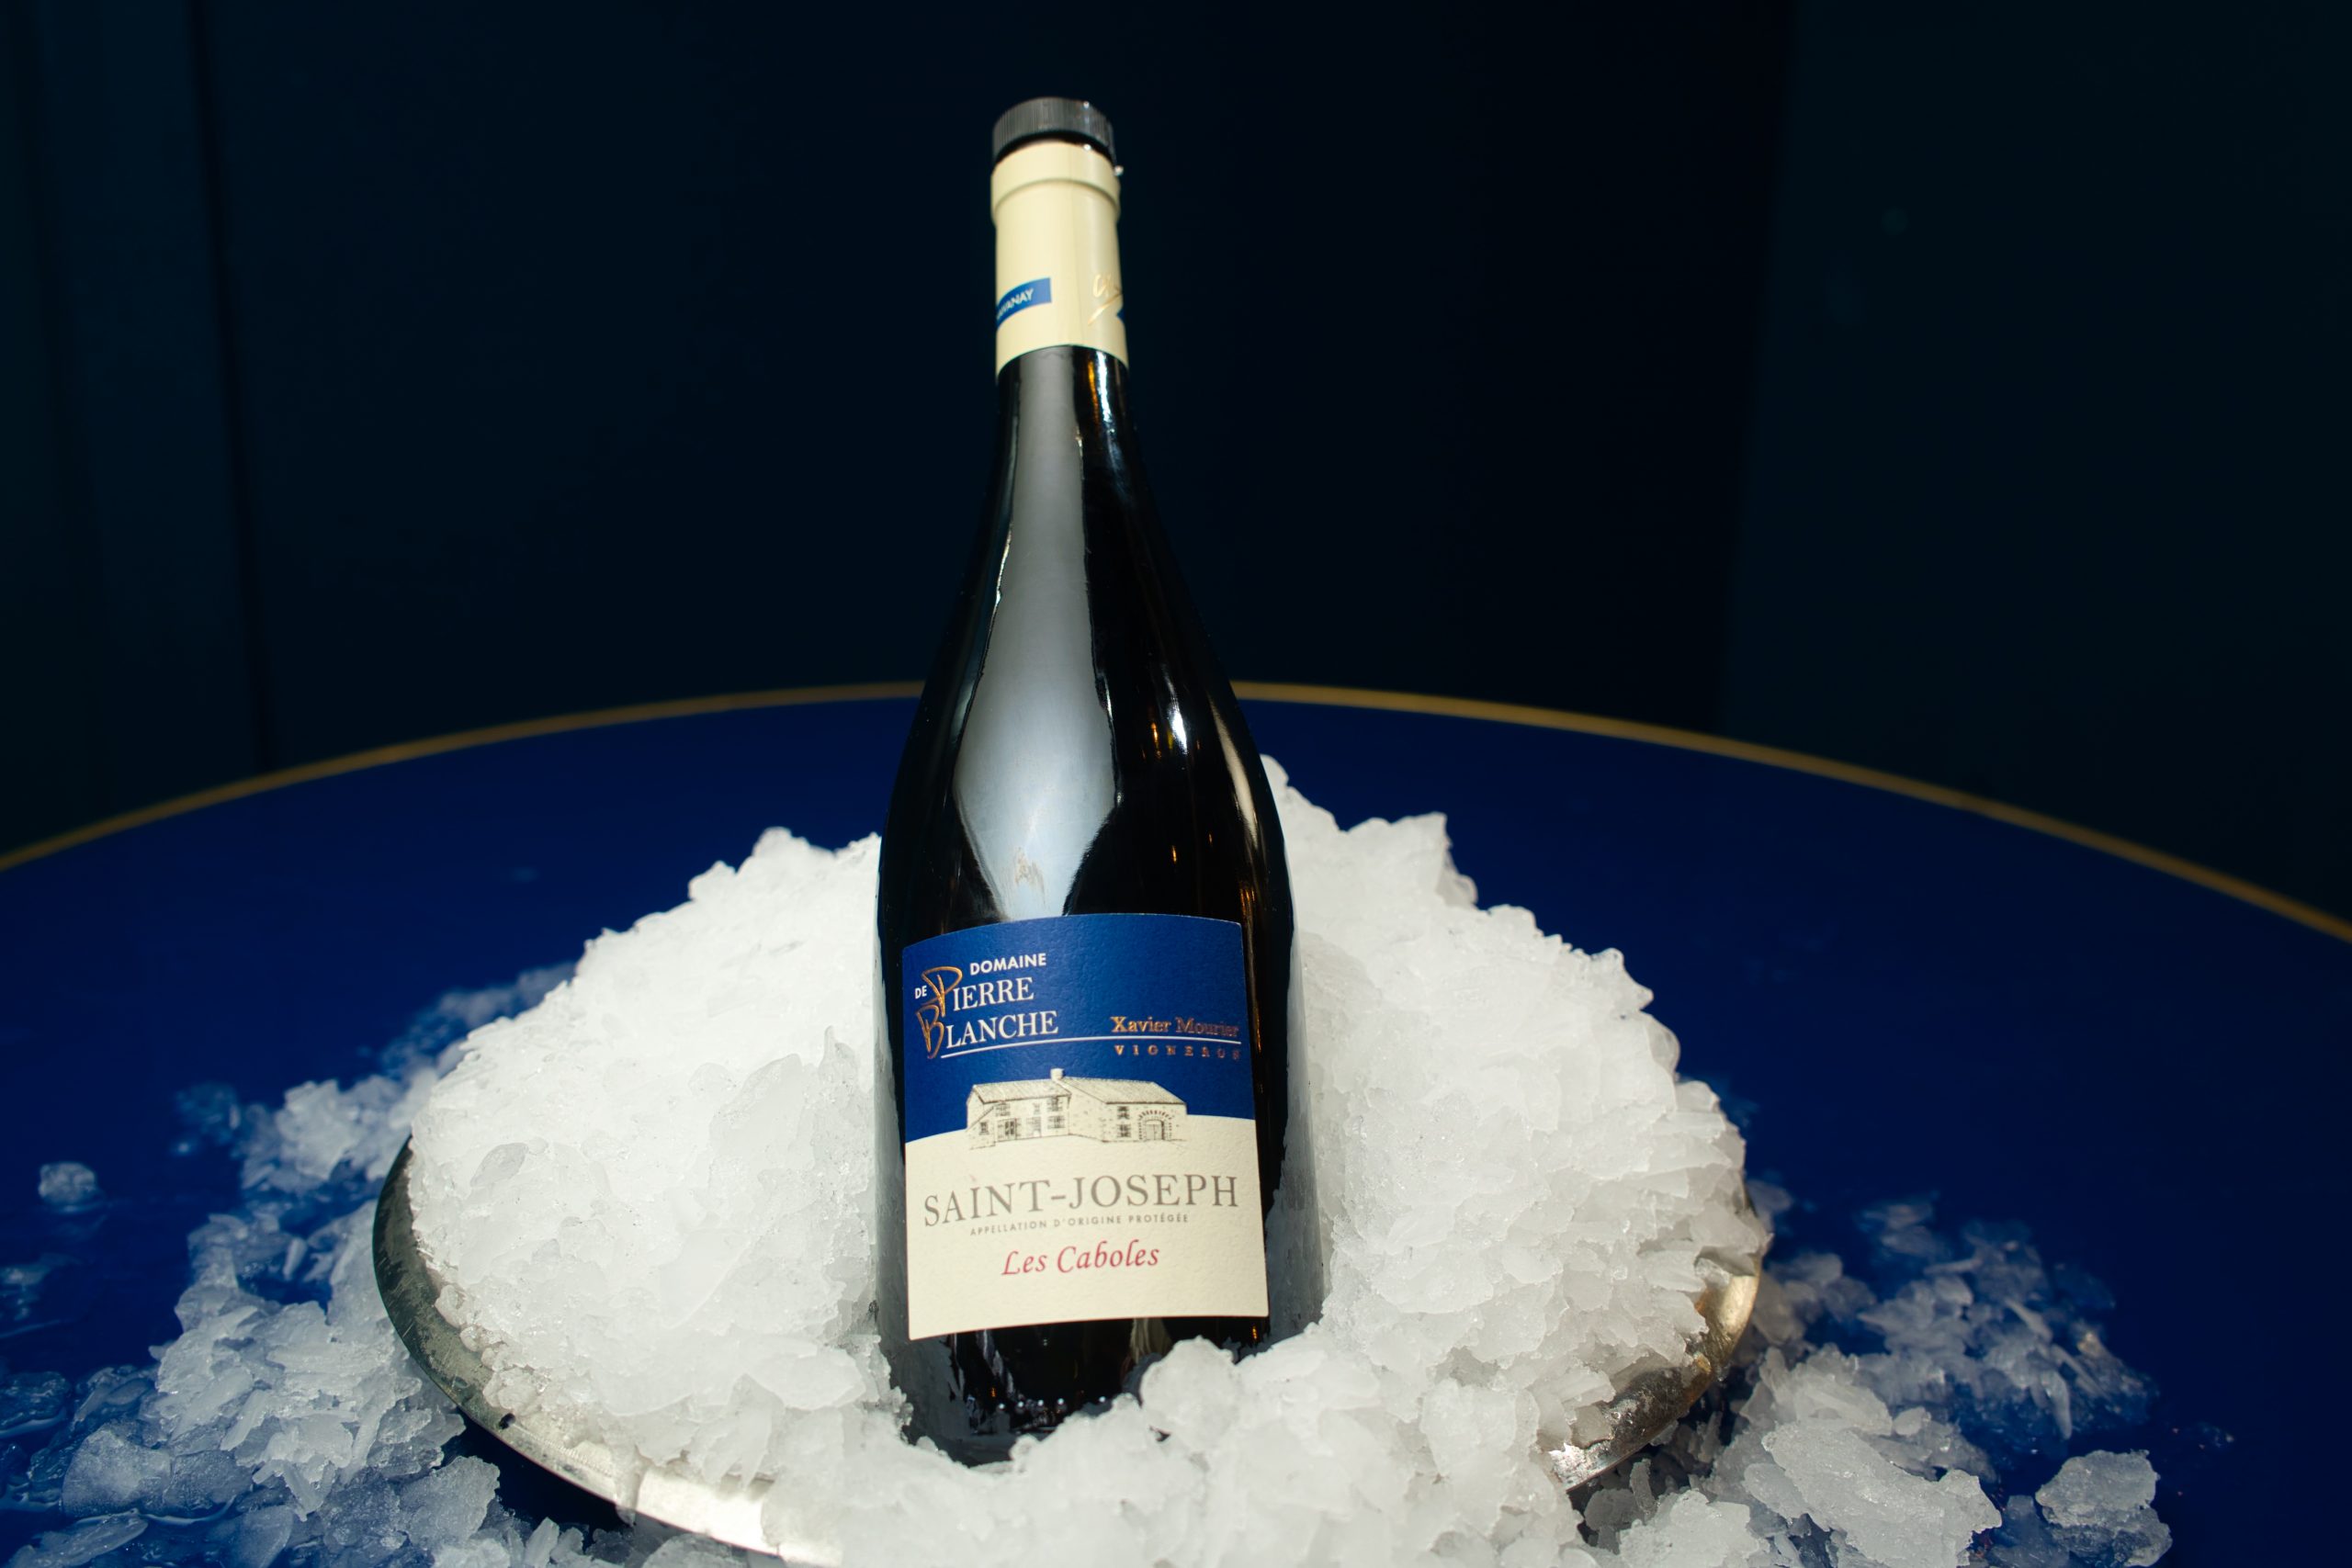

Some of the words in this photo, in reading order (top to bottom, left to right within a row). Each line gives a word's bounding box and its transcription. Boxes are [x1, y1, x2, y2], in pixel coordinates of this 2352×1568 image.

[970, 953, 1046, 976] DOMAINE
[915, 986, 928, 998] DE
[921, 966, 1035, 1018] PIERRE
[916, 1005, 1059, 1059] BLANCHE
[1110, 1016, 1172, 1033] Xavier
[1175, 1016, 1239, 1037] Mourier
[923, 1174, 1238, 1227] SAINT-JOSEPH
[970, 1220, 1047, 1236] APPELLATION
[1054, 1215, 1122, 1228] D'ORIGINE
[1128, 1212, 1189, 1224] PROTÉGÉE
[1001, 1250, 1047, 1276] Les
[1057, 1239, 1160, 1273] Caboles
